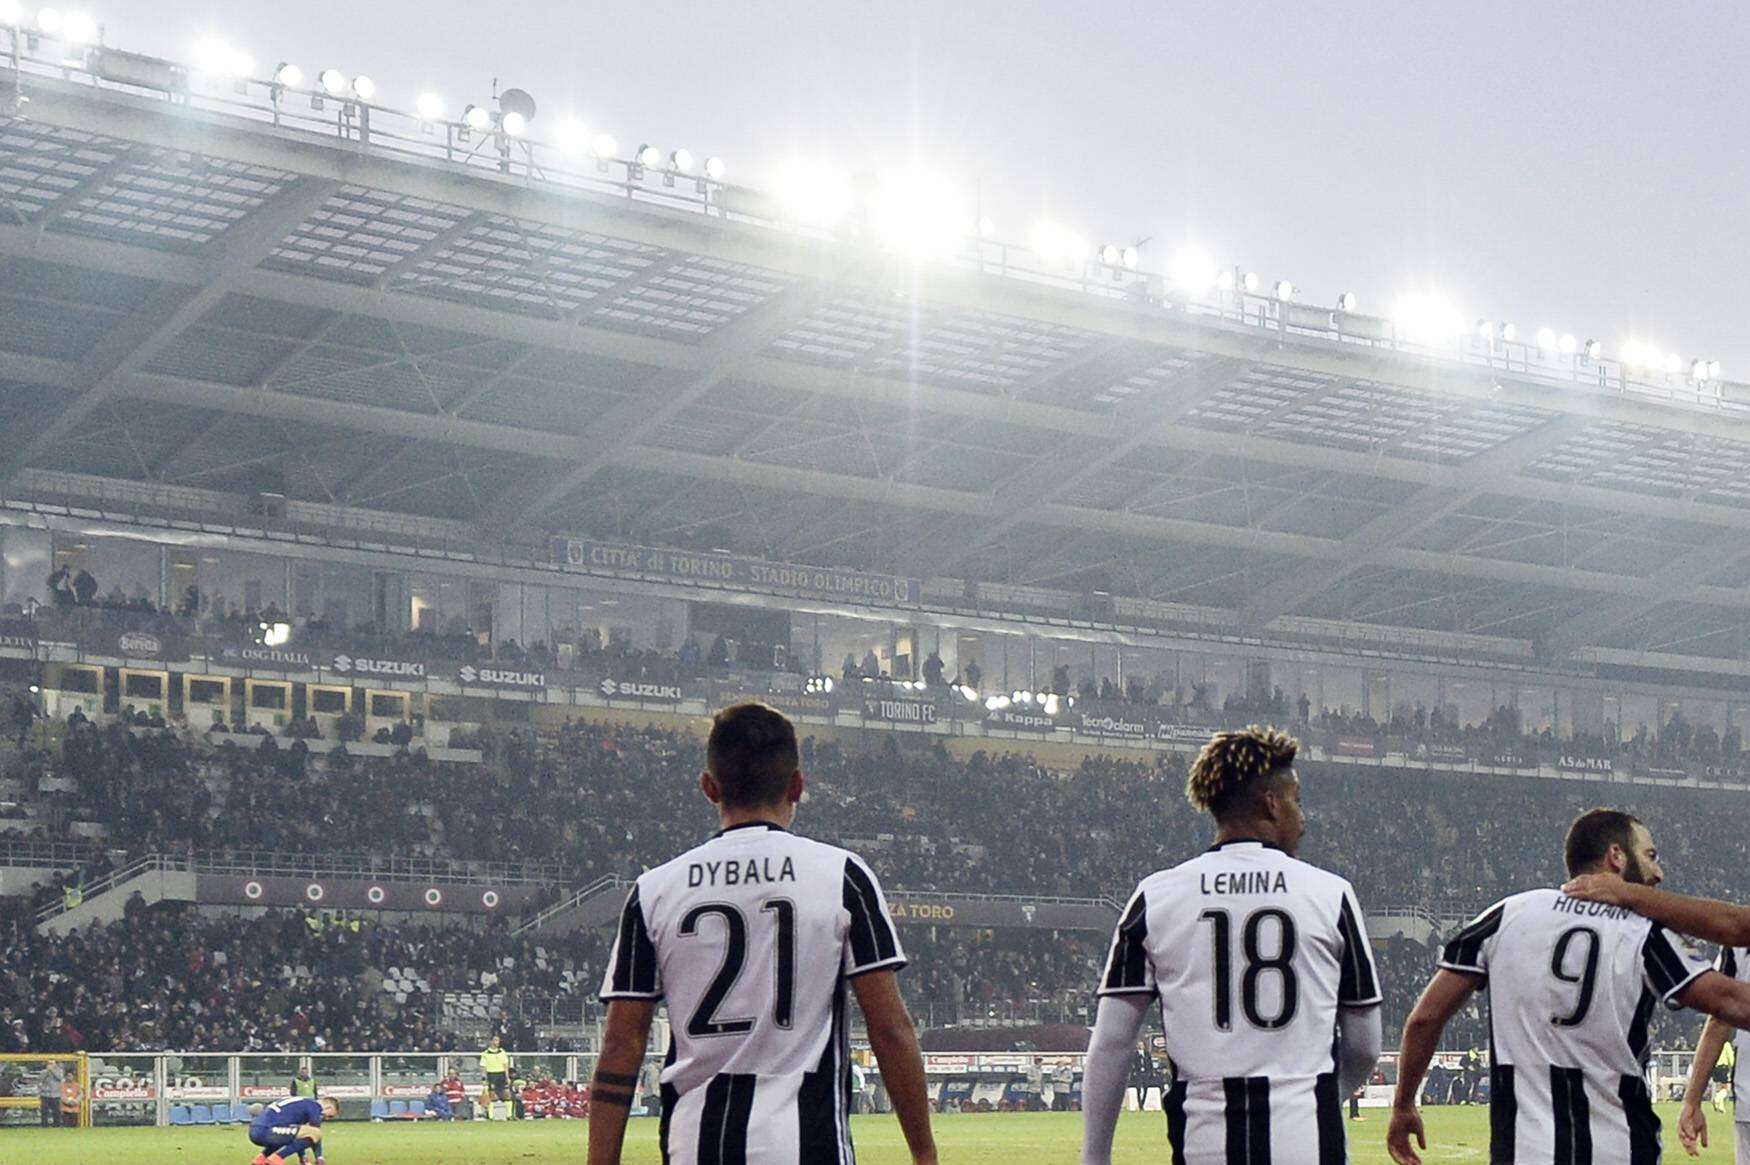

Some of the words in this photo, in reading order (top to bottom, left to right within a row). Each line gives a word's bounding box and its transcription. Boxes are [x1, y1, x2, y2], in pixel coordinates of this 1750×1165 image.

[671, 556, 732, 577] TORINO
[751, 565, 809, 588] STADIO
[814, 573, 890, 596] OLIMPICO
[355, 659, 424, 676] SUZUKI
[480, 669, 545, 686] SUZUKI
[620, 683, 681, 699] SUZUKI
[881, 700, 920, 720] TORINO
[922, 704, 936, 721] FC
[1005, 712, 1052, 727] Kappa
[688, 856, 796, 888] DYBALA
[1201, 871, 1288, 894] LEMINA
[910, 904, 954, 919] TORO
[677, 896, 798, 1039] 21
[1197, 905, 1300, 1033] 18
[1550, 926, 1600, 1027] 9
[95, 1087, 149, 1098] Campiello
